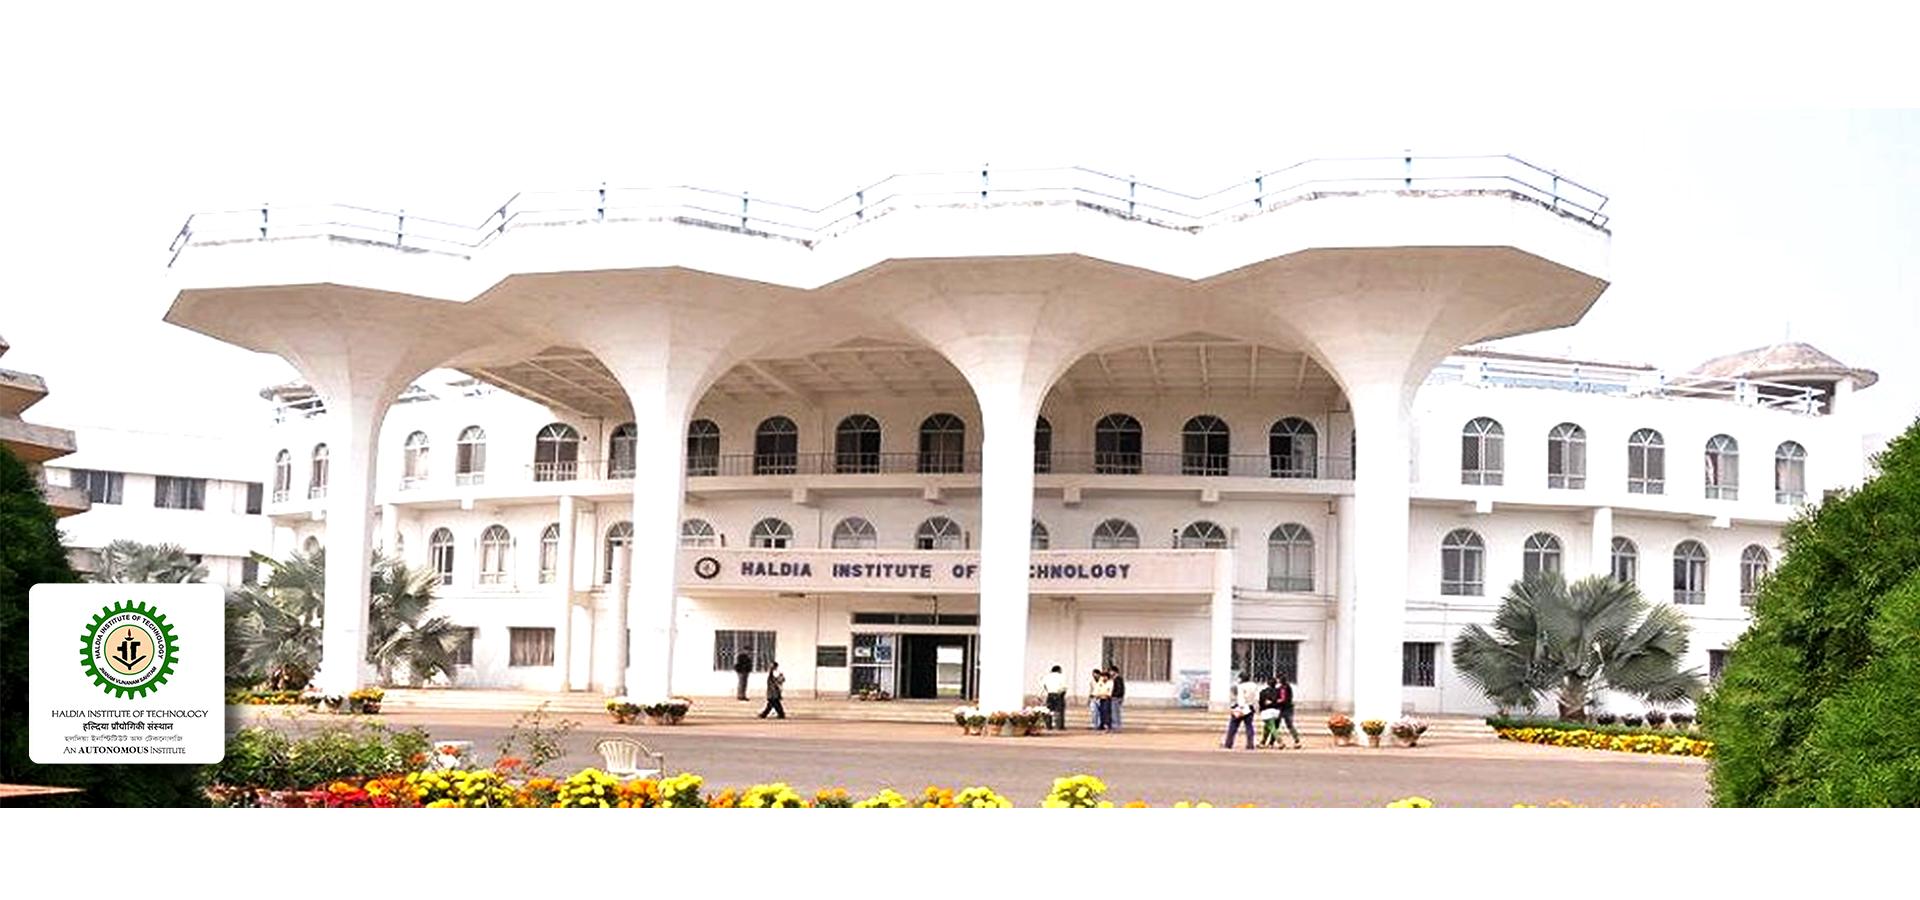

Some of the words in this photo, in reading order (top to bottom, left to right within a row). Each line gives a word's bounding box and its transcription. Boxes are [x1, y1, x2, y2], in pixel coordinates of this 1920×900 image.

[741, 561, 812, 577] HALDIA
[832, 563, 932, 578] INSTITUTE
[952, 564, 977, 578] OF
